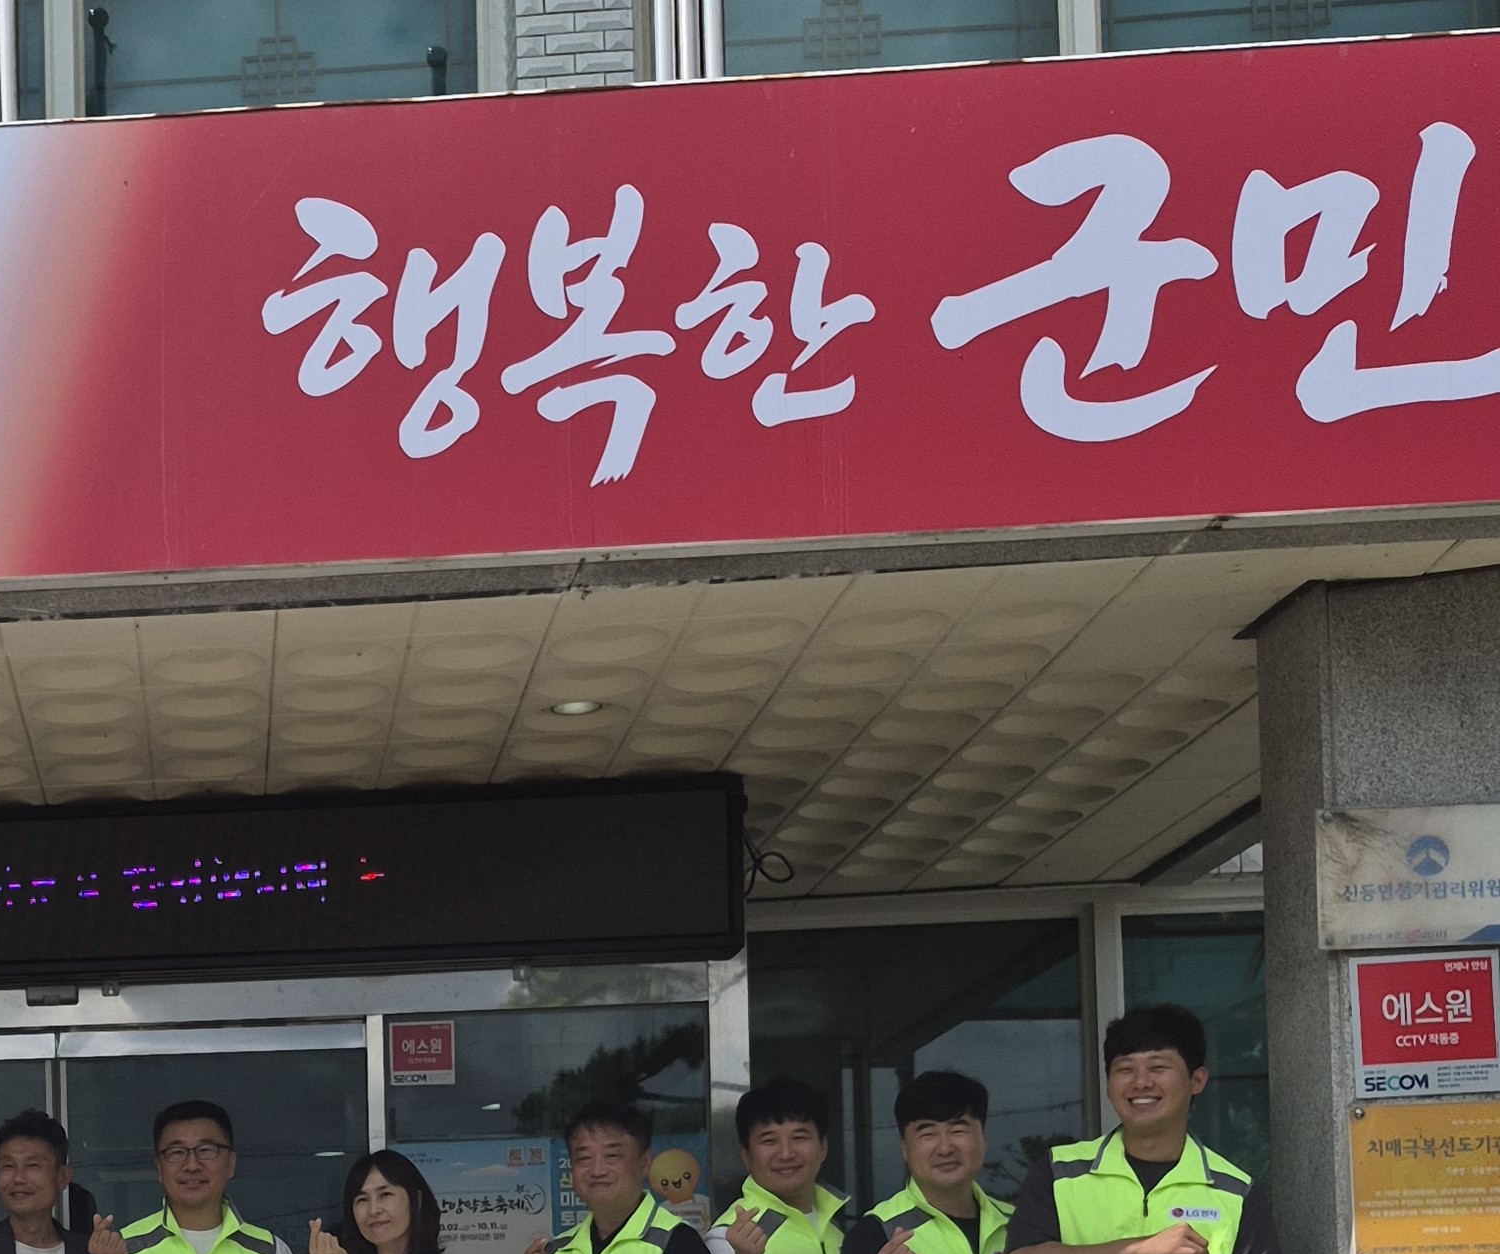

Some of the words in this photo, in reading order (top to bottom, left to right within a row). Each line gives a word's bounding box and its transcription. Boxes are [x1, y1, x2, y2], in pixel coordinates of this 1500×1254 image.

[261, 183, 875, 487] 행복한
[929, 121, 1500, 442] 군민
[1444, 961, 1469, 972] 언제나
[1381, 989, 1473, 1026] 에스원
[401, 1038, 442, 1055] 에스원
[1395, 1034, 1427, 1047] CCTV
[1428, 1032, 1460, 1045] 작동중
[393, 1073, 427, 1084] SECOM
[1364, 1074, 1430, 1092] SECOM
